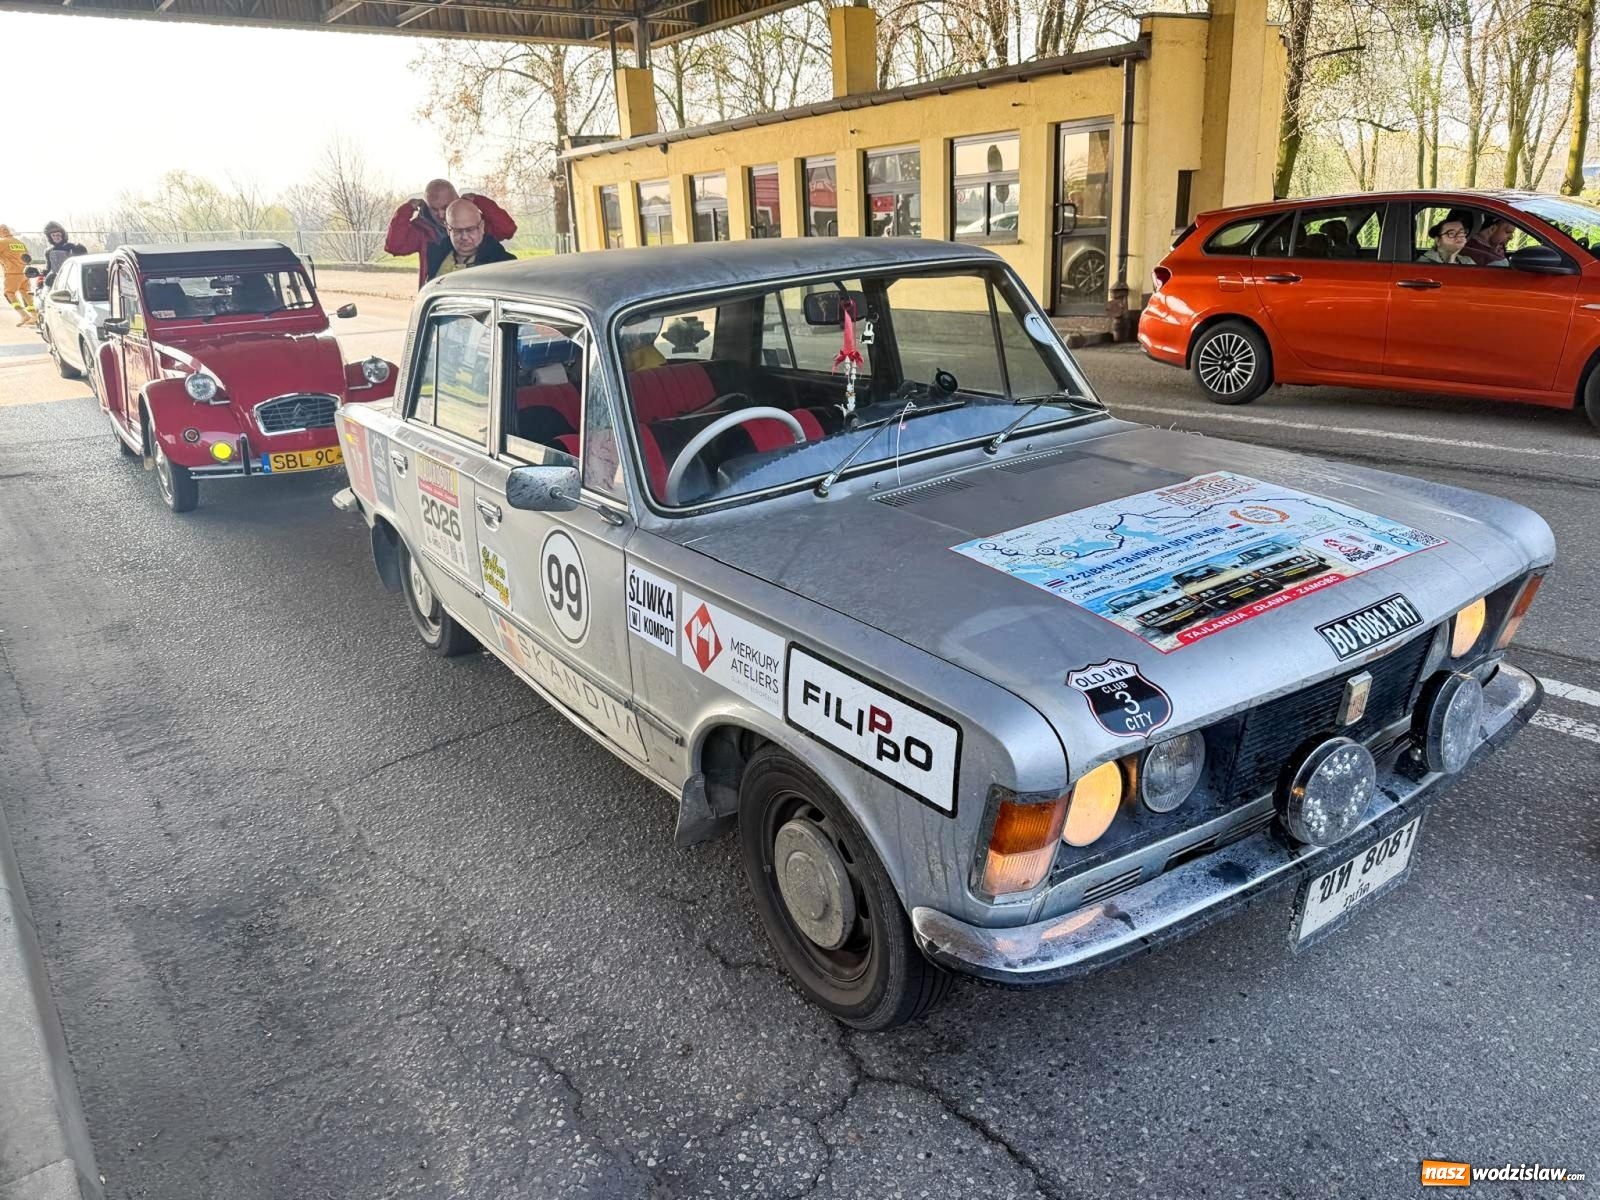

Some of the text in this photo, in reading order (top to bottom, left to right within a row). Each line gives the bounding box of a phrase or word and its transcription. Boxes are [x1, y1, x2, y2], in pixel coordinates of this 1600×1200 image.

[273, 453, 311, 470] SBL
[421, 494, 461, 542] 2026
[547, 553, 583, 622] 99
[628, 569, 675, 622] ŚLIWKA
[1184, 612, 1248, 640] TAJLANDIA
[1253, 594, 1290, 612] OŁAWA
[1299, 574, 1340, 595] ZAMOŚĆ
[1346, 608, 1397, 645] 8081
[1380, 596, 1419, 630] PKT
[643, 616, 675, 648] KOMPOT
[730, 637, 780, 675] MERKURY
[730, 657, 779, 694] ATELIERS
[1075, 665, 1129, 688] OLD VW
[1101, 681, 1129, 694] CLUB
[1115, 691, 1141, 715] 3
[1125, 711, 1154, 731] CITY
[802, 679, 934, 773] FILIPPO
[1361, 821, 1416, 875] 8081
